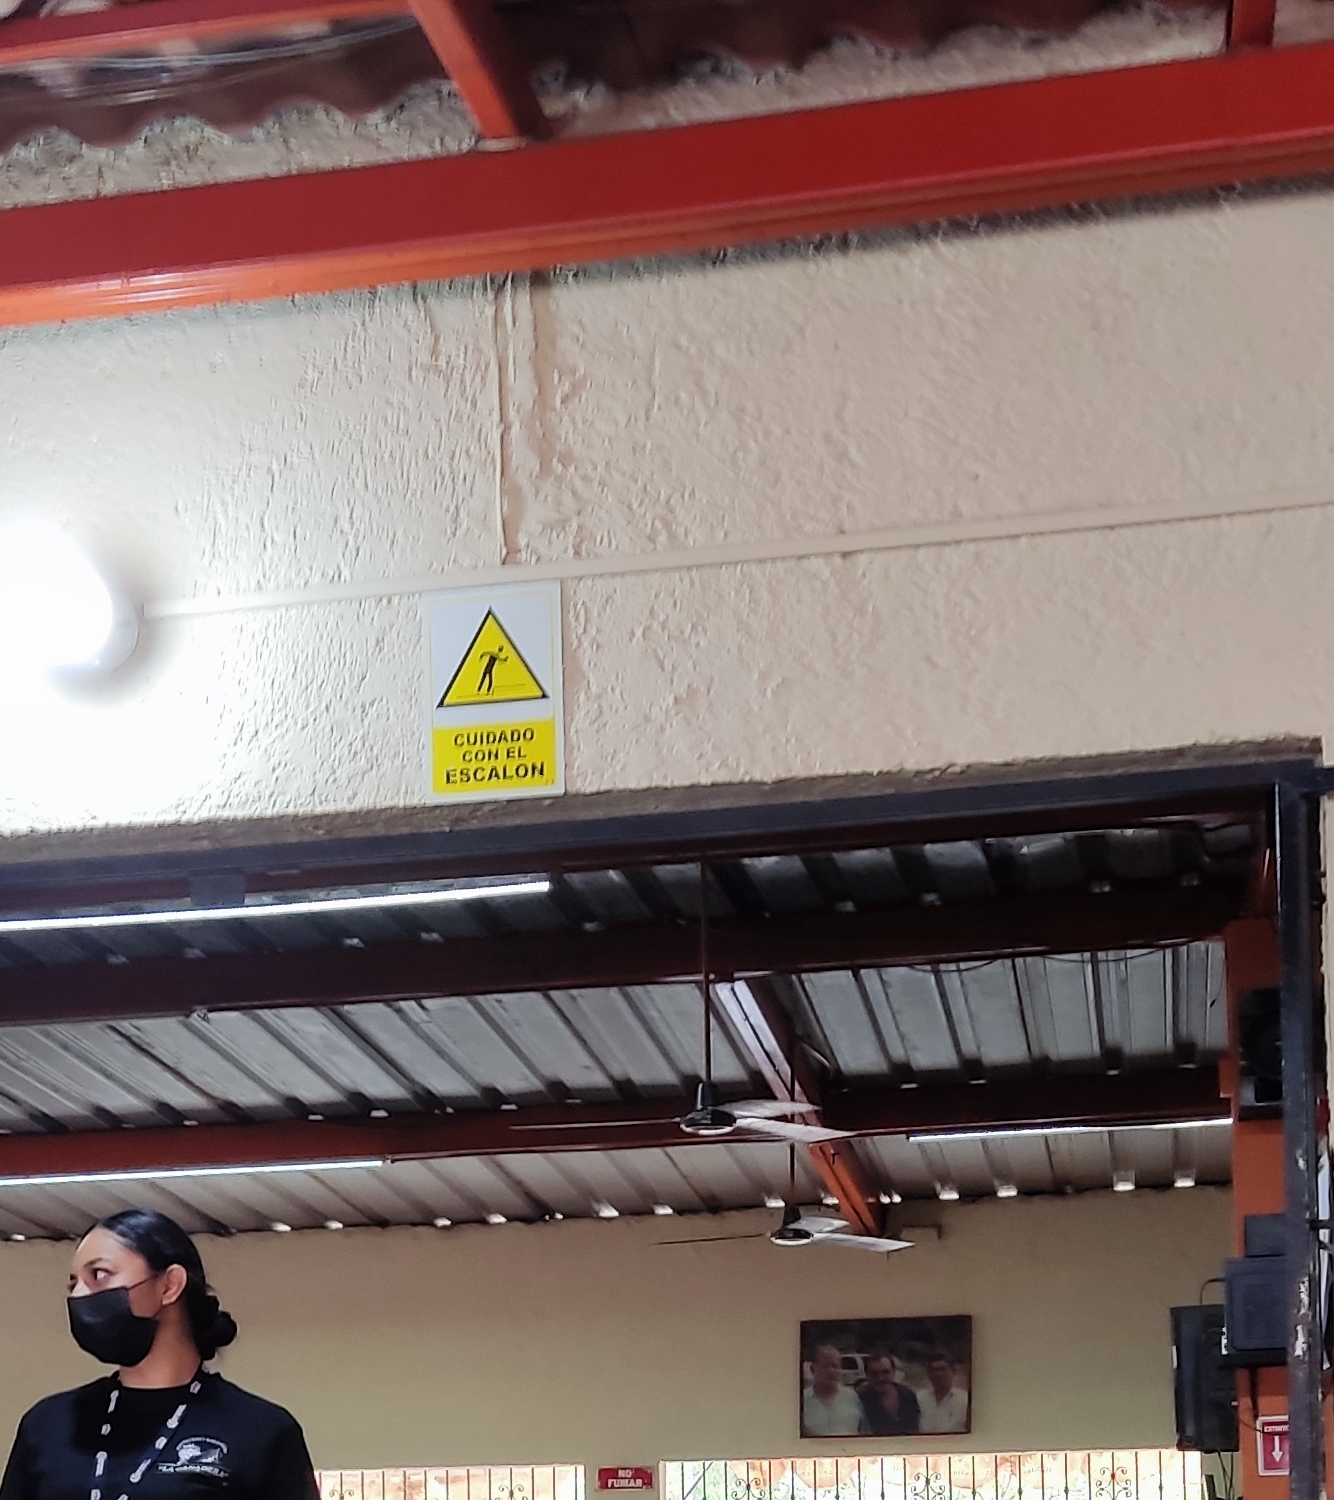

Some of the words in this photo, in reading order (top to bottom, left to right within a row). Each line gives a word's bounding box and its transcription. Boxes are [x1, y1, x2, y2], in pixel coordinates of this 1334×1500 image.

[453, 727, 535, 747] CUIDADO
[462, 748, 499, 762] CON
[506, 746, 527, 760] EL
[617, 1469, 633, 1478] NO
